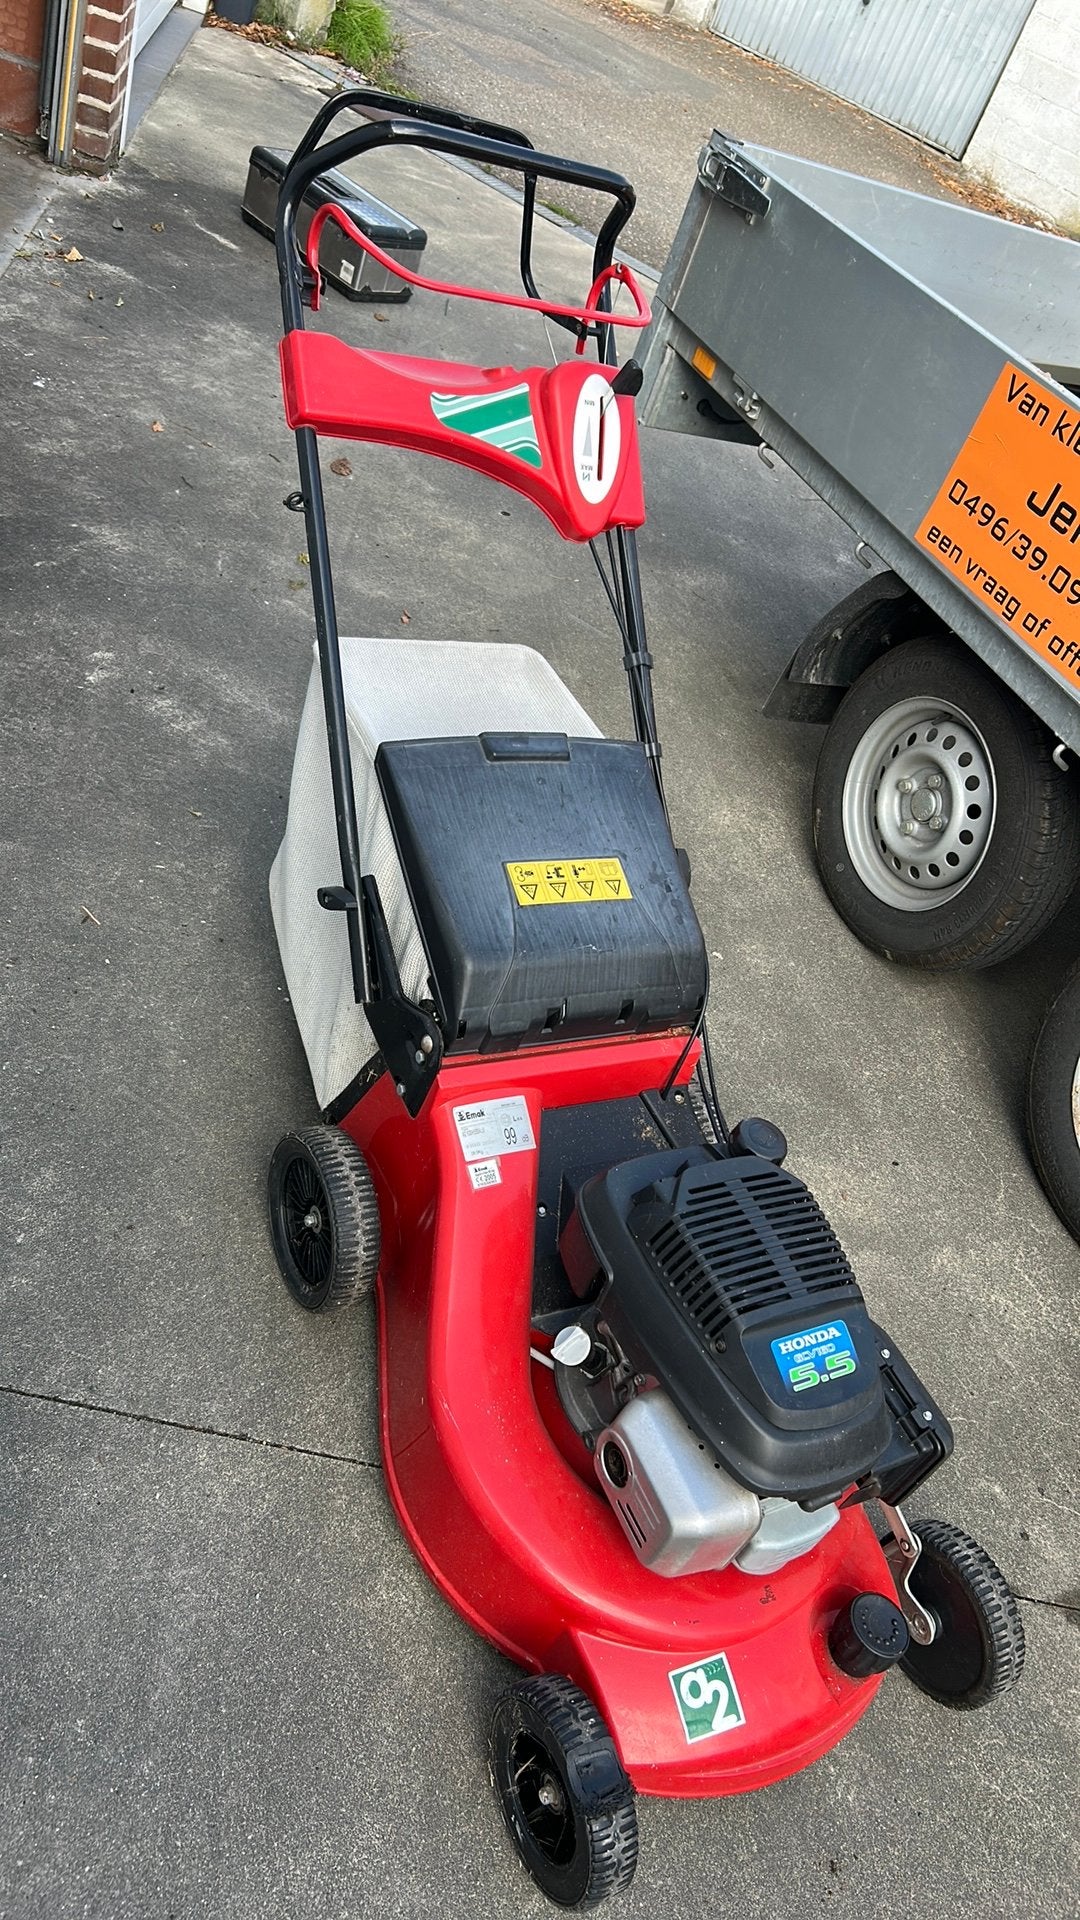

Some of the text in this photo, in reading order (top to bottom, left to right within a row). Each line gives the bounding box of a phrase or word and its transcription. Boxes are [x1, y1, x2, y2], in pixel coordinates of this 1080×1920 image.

[1007, 373, 1050, 427] Van
[926, 526, 1080, 677] een vraag of off
[465, 1109, 485, 1120] Emak
[503, 1127, 517, 1145] 99
[778, 1326, 842, 1355] HONDA
[789, 1350, 857, 1392] 5.5
